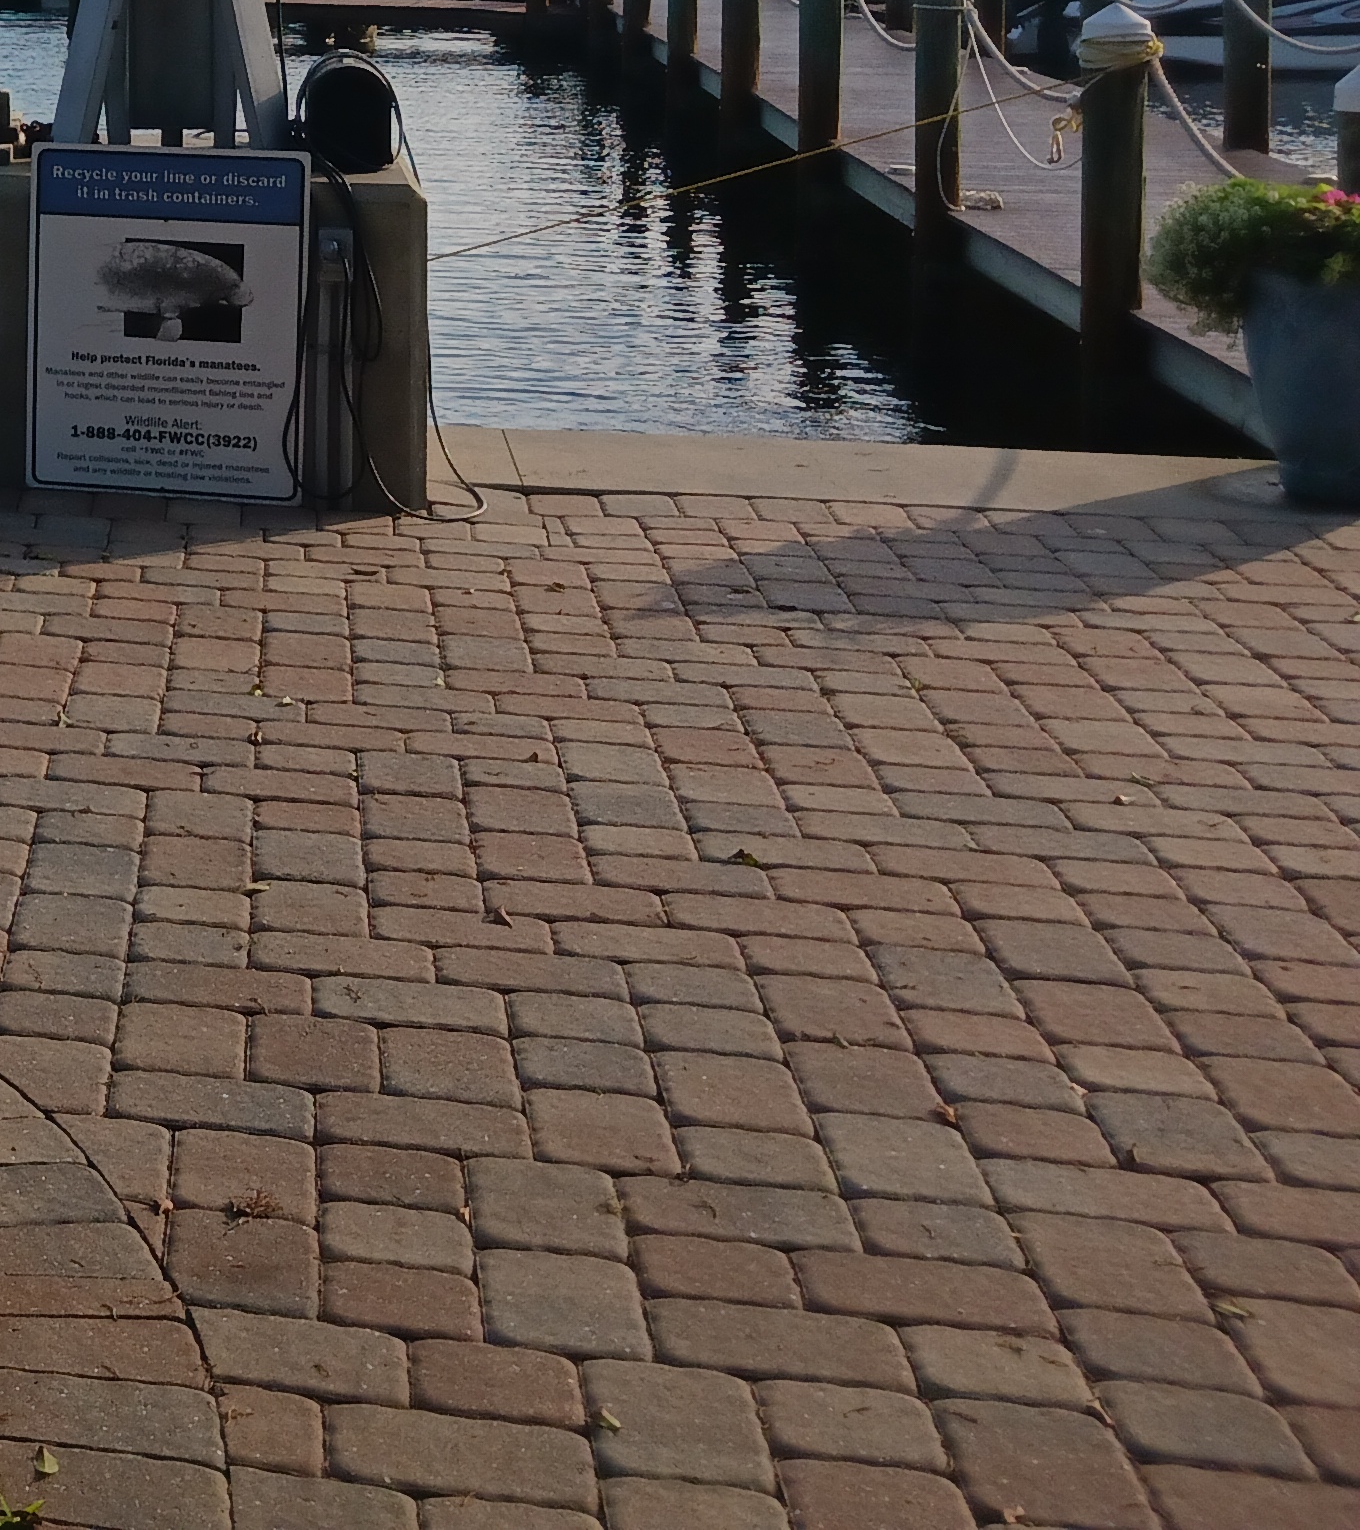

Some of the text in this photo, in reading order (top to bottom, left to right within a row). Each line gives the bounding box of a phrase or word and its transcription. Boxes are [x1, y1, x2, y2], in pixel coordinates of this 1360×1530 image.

[52, 165, 287, 188] Recycle your line or discard
[77, 185, 260, 206] it in trash containers.
[71, 350, 261, 372] Help protect Florida's manatees.
[45, 366, 86, 377] Manatees
[88, 370, 104, 378] and
[105, 371, 128, 380] other
[130, 373, 160, 382] wildlife
[179, 376, 204, 385] easily
[206, 377, 240, 386] become
[242, 380, 286, 391] entangled
[104, 382, 145, 392] discarded
[208, 388, 237, 399] fishing
[239, 390, 255, 399] line
[257, 392, 273, 400] and
[94, 393, 118, 402] which
[137, 395, 156, 405] lead
[168, 399, 199, 408] serious
[201, 400, 224, 410] injury
[237, 402, 264, 411] death.
[124, 415, 203, 431] Wildlife Alert:
[70, 424, 258, 452] 1-888-404-FWCC(3922)
[56, 451, 87, 461] Report
[156, 458, 179, 468] dead
[192, 461, 223, 471] injured
[73, 465, 90, 473] and
